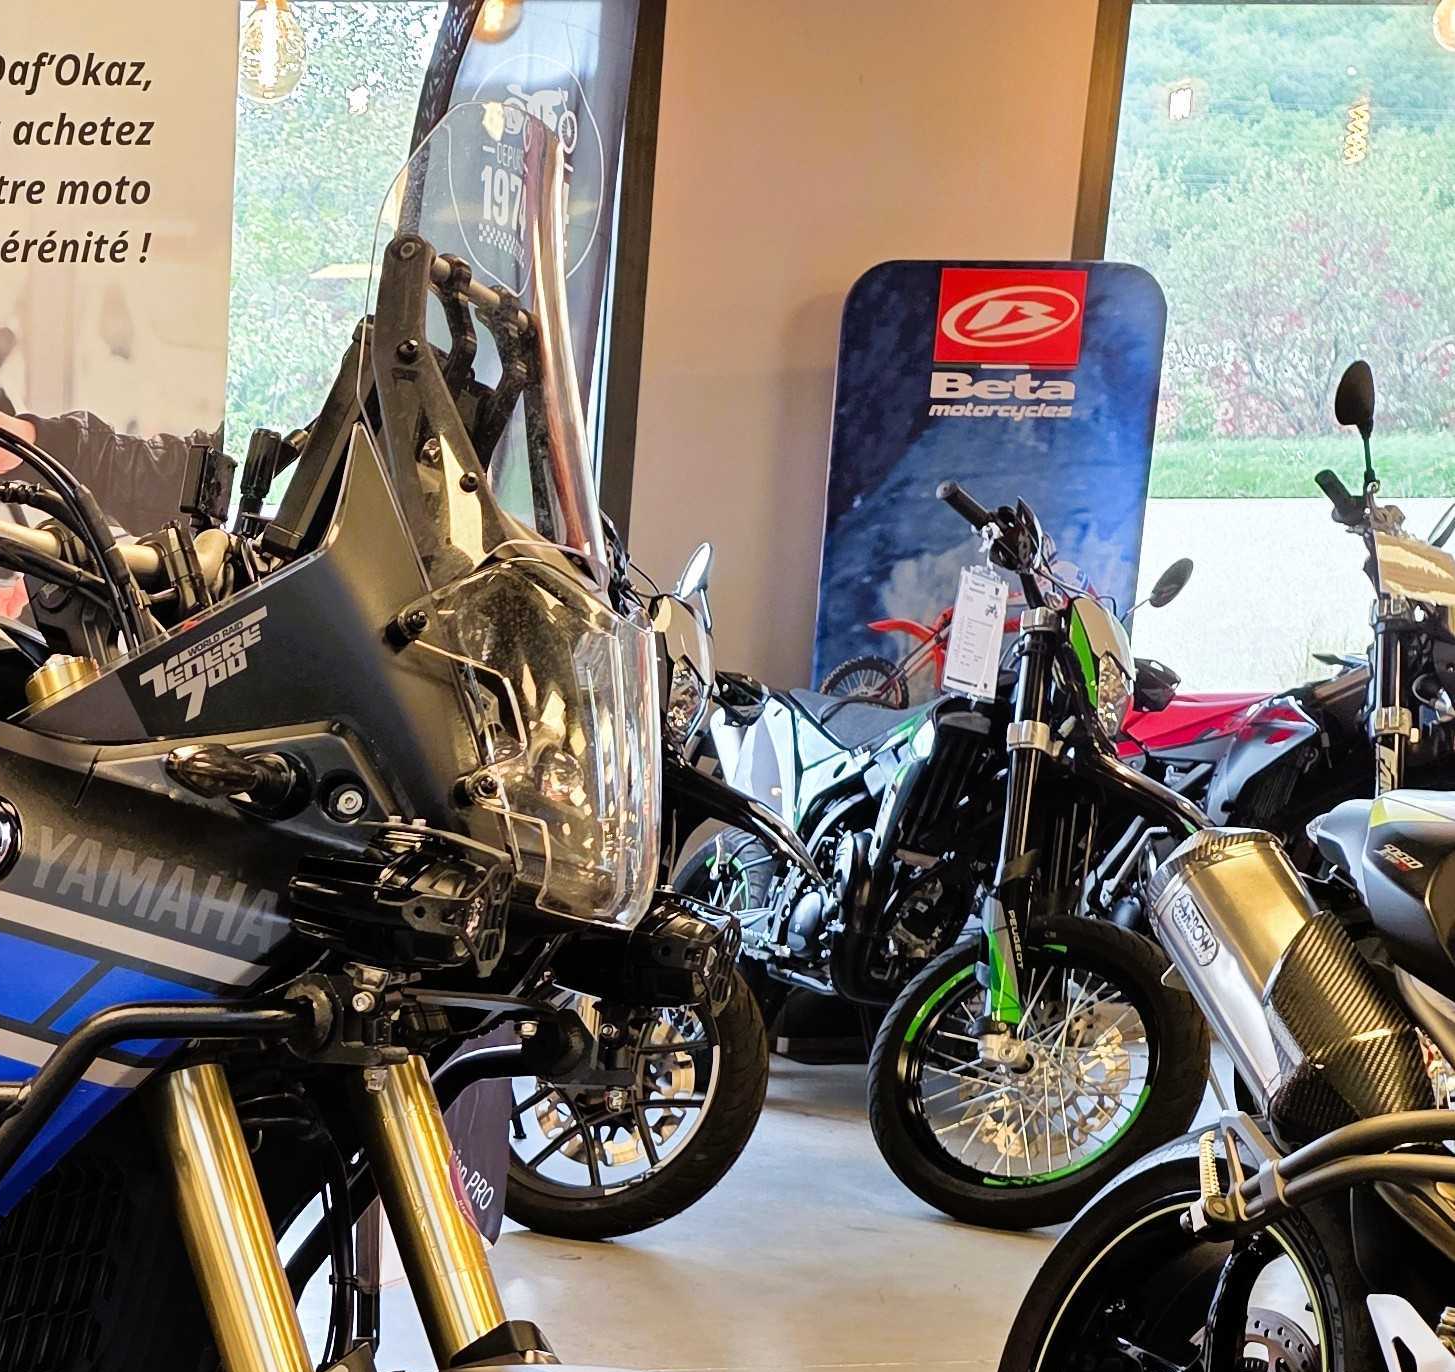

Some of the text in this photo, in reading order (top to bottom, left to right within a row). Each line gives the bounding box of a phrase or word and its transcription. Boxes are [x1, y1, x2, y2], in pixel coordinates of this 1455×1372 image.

[12, 112, 155, 146] achetez
[56, 175, 151, 205] moto
[139, 232, 152, 264] !
[929, 371, 1076, 400] Beta
[928, 402, 1073, 422] motorcycles
[176, 650, 248, 723] 700
[32, 825, 279, 953] YAMAHA
[1008, 909, 1024, 969] PEUGEOT
[465, 1170, 495, 1210] PRO
